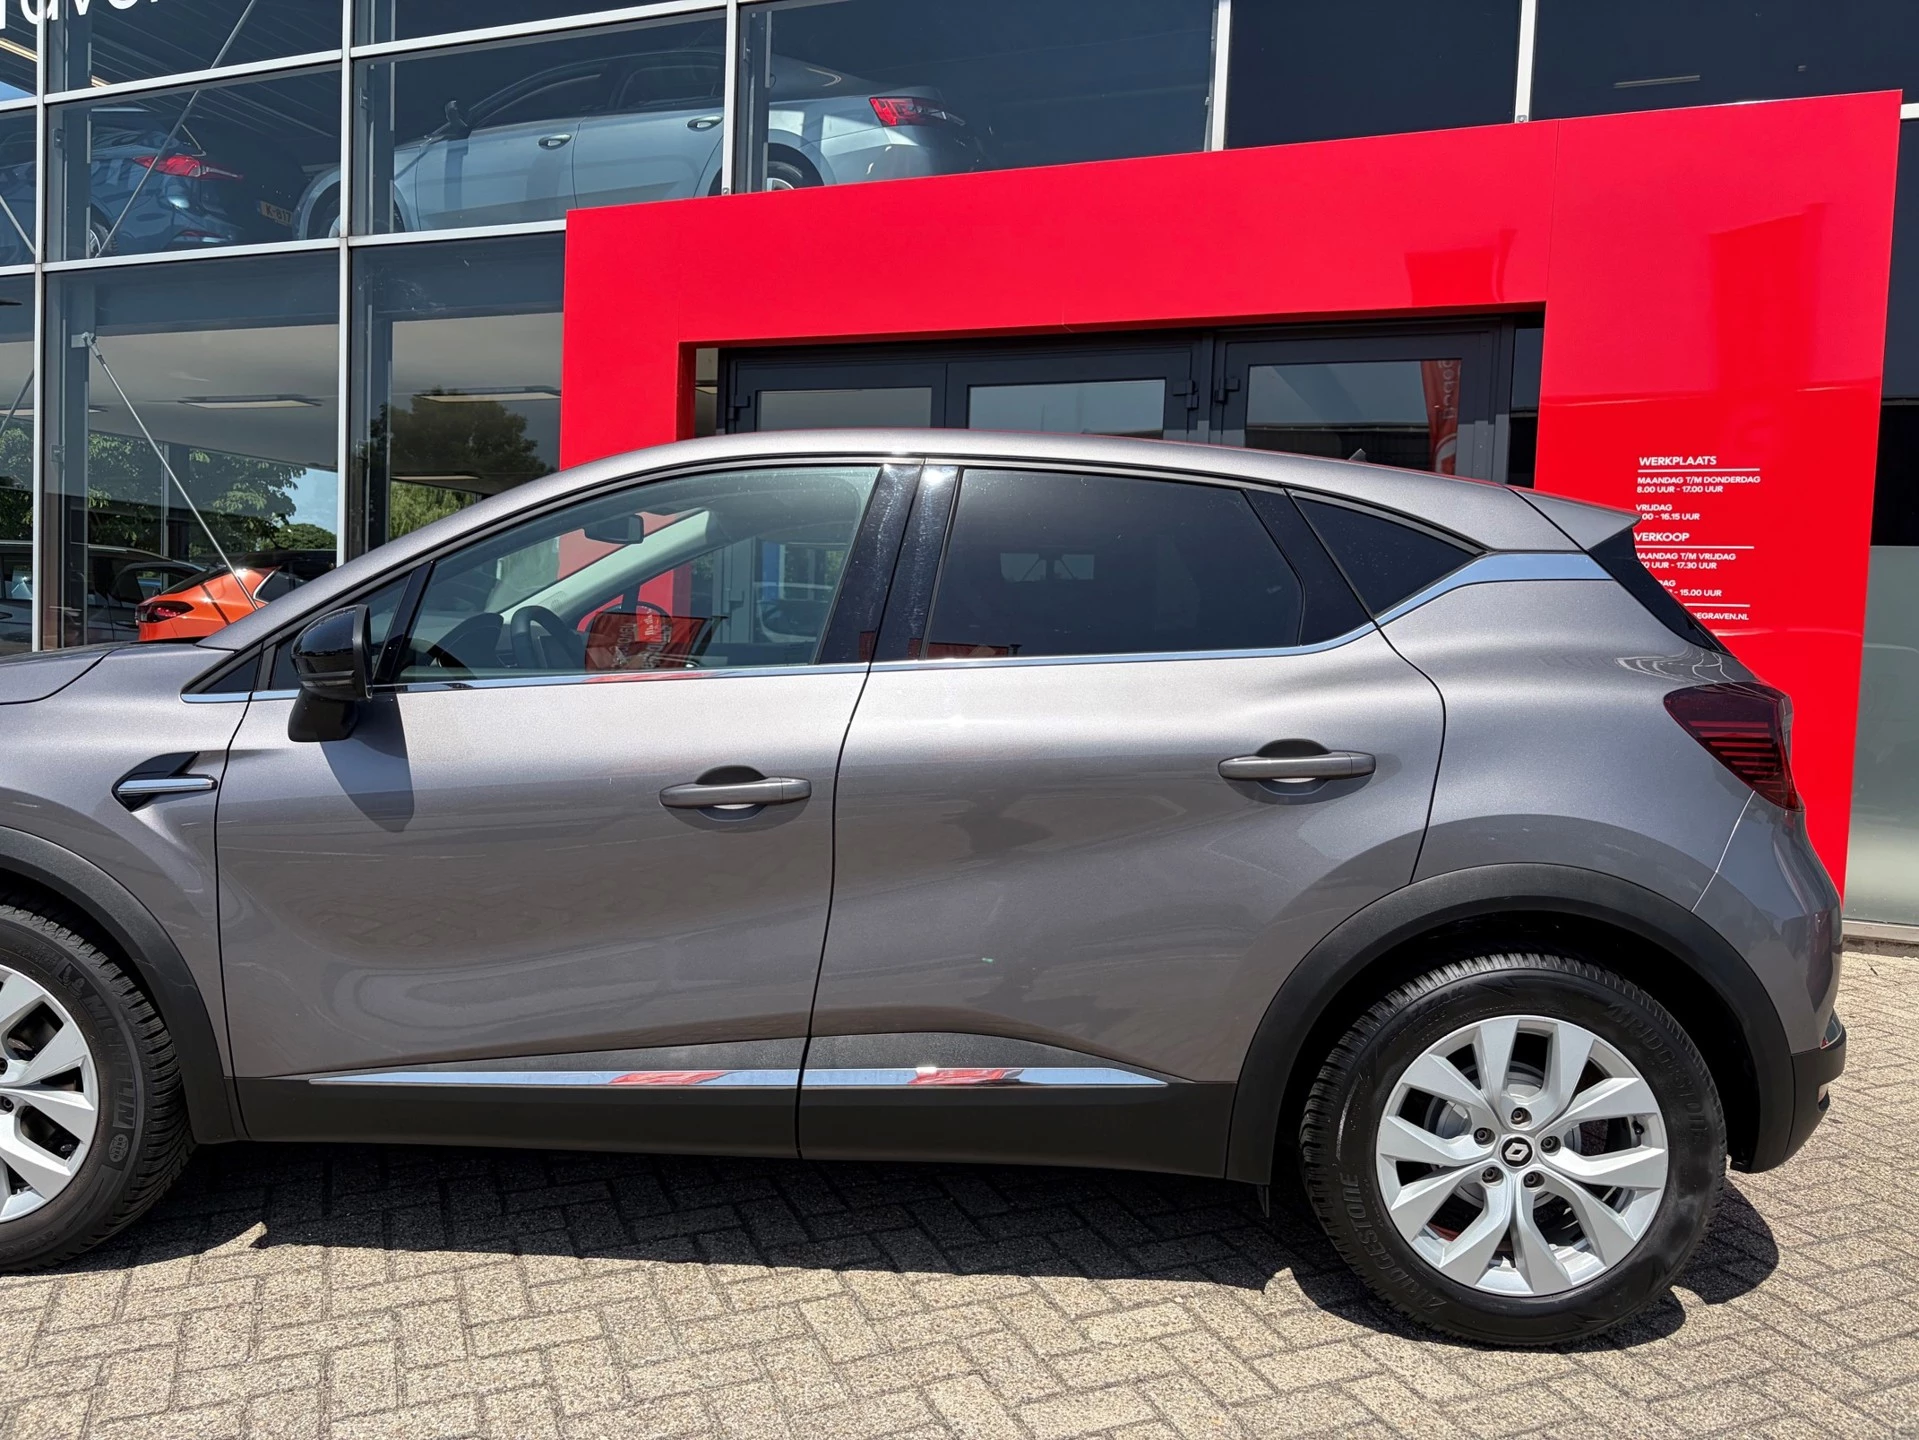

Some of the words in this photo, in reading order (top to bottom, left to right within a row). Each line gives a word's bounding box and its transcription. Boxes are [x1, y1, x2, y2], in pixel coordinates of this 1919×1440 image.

[1639, 456, 1717, 466] WERKPLAATS
[1685, 476, 1702, 484] T/M
[1682, 485, 1703, 493] 17.00
[1704, 485, 1723, 493] UUR
[1634, 532, 1690, 542] VERKOOP
[1680, 552, 1697, 560] T/M
[1698, 552, 1736, 561] VRIJDAG
[1652, 561, 1669, 569] UUR
[1680, 589, 1702, 597] 15.00
[1703, 589, 1722, 597] UUR
[1692, 612, 1749, 620] EGRAVEN.NL
